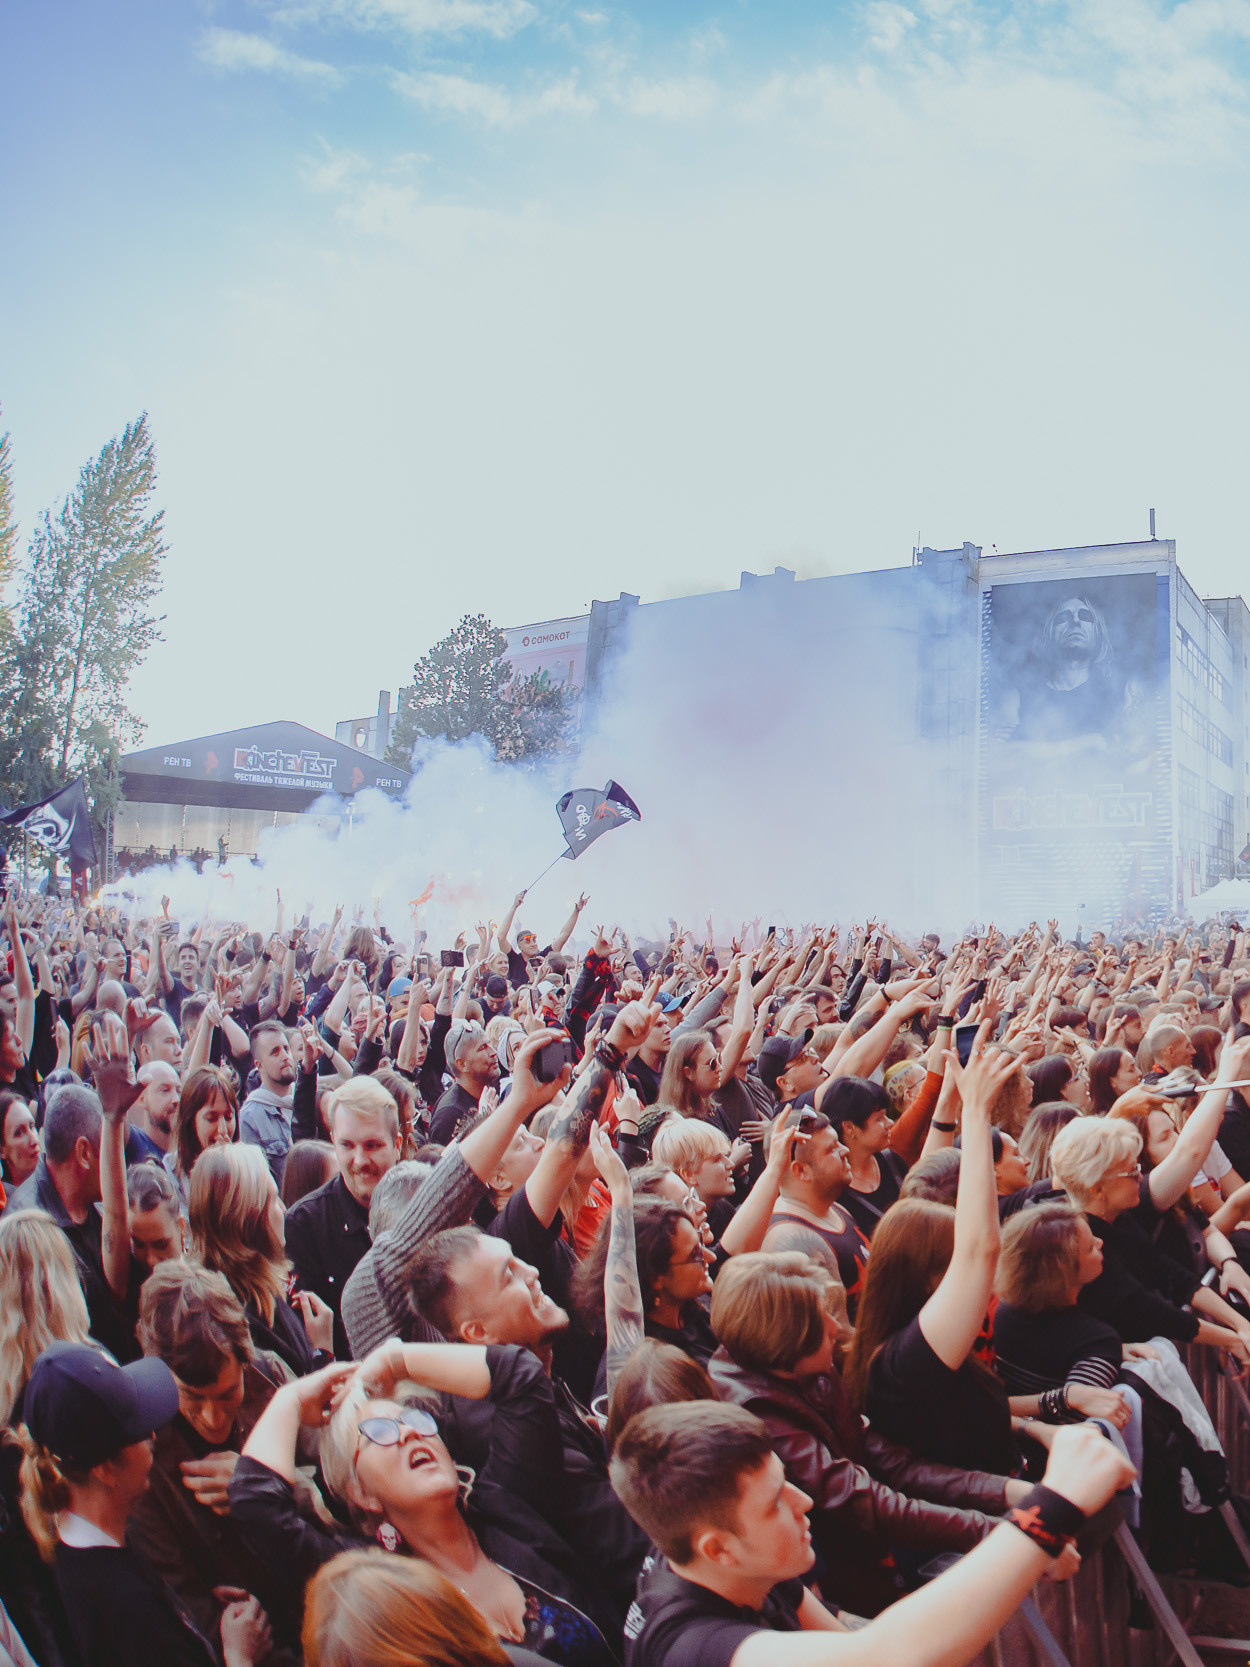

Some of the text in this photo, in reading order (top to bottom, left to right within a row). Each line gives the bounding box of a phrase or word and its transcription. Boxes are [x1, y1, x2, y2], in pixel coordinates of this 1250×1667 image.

[163, 756, 192, 768] РЕН ТВ
[234, 772, 333, 790] ФЕСТИВАЛЬ ТЯЖЕЛОЙ МУЗЫКИ
[376, 778, 402, 788] РЕН ТВ
